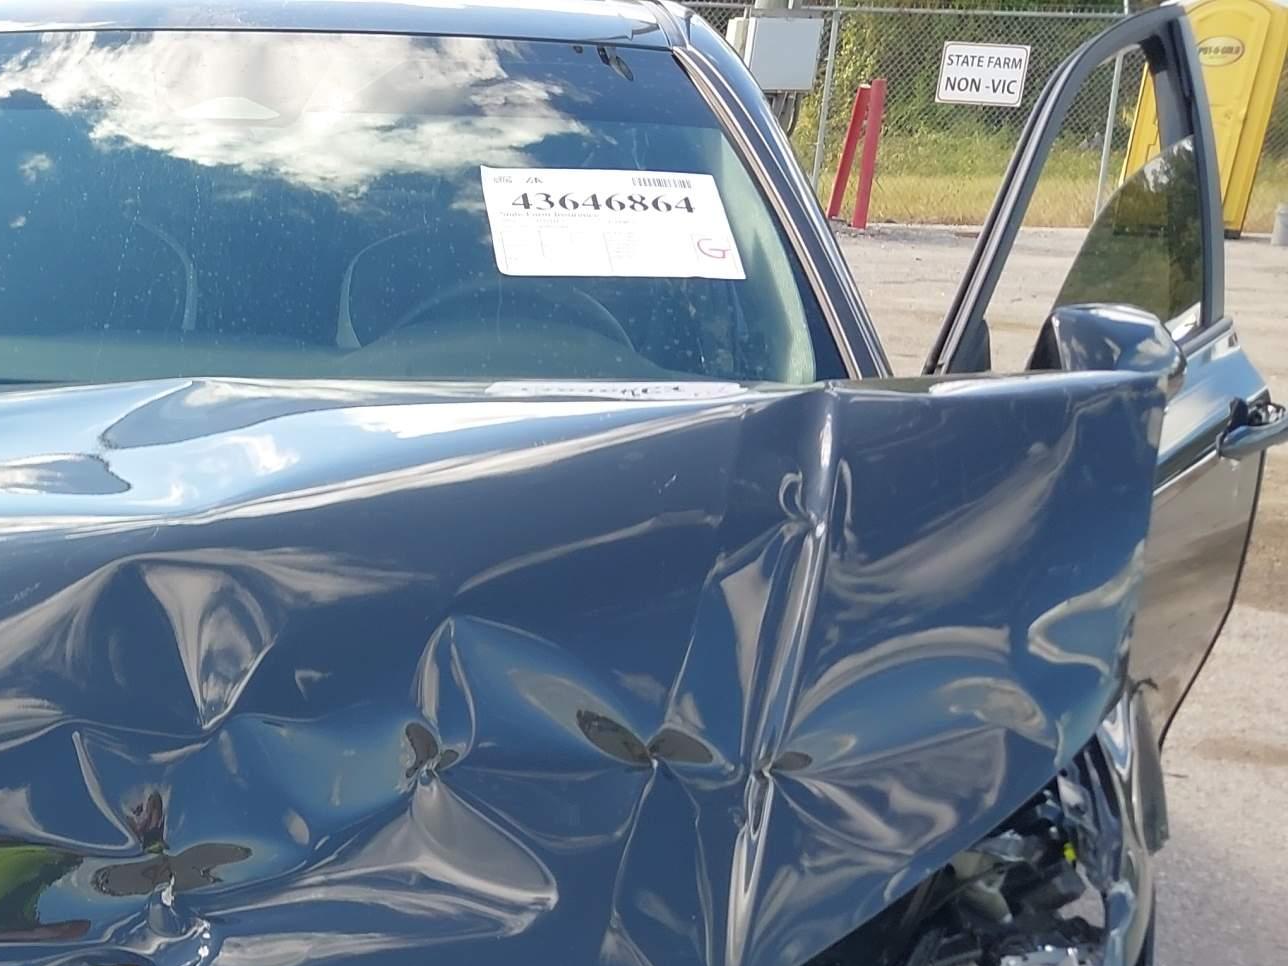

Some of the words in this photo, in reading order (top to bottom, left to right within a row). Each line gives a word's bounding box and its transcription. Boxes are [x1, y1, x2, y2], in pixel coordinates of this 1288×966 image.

[946, 53, 984, 68] STATE
[986, 56, 1023, 70] FARM
[944, 76, 981, 92] NON
[512, 192, 696, 213] 43646864
